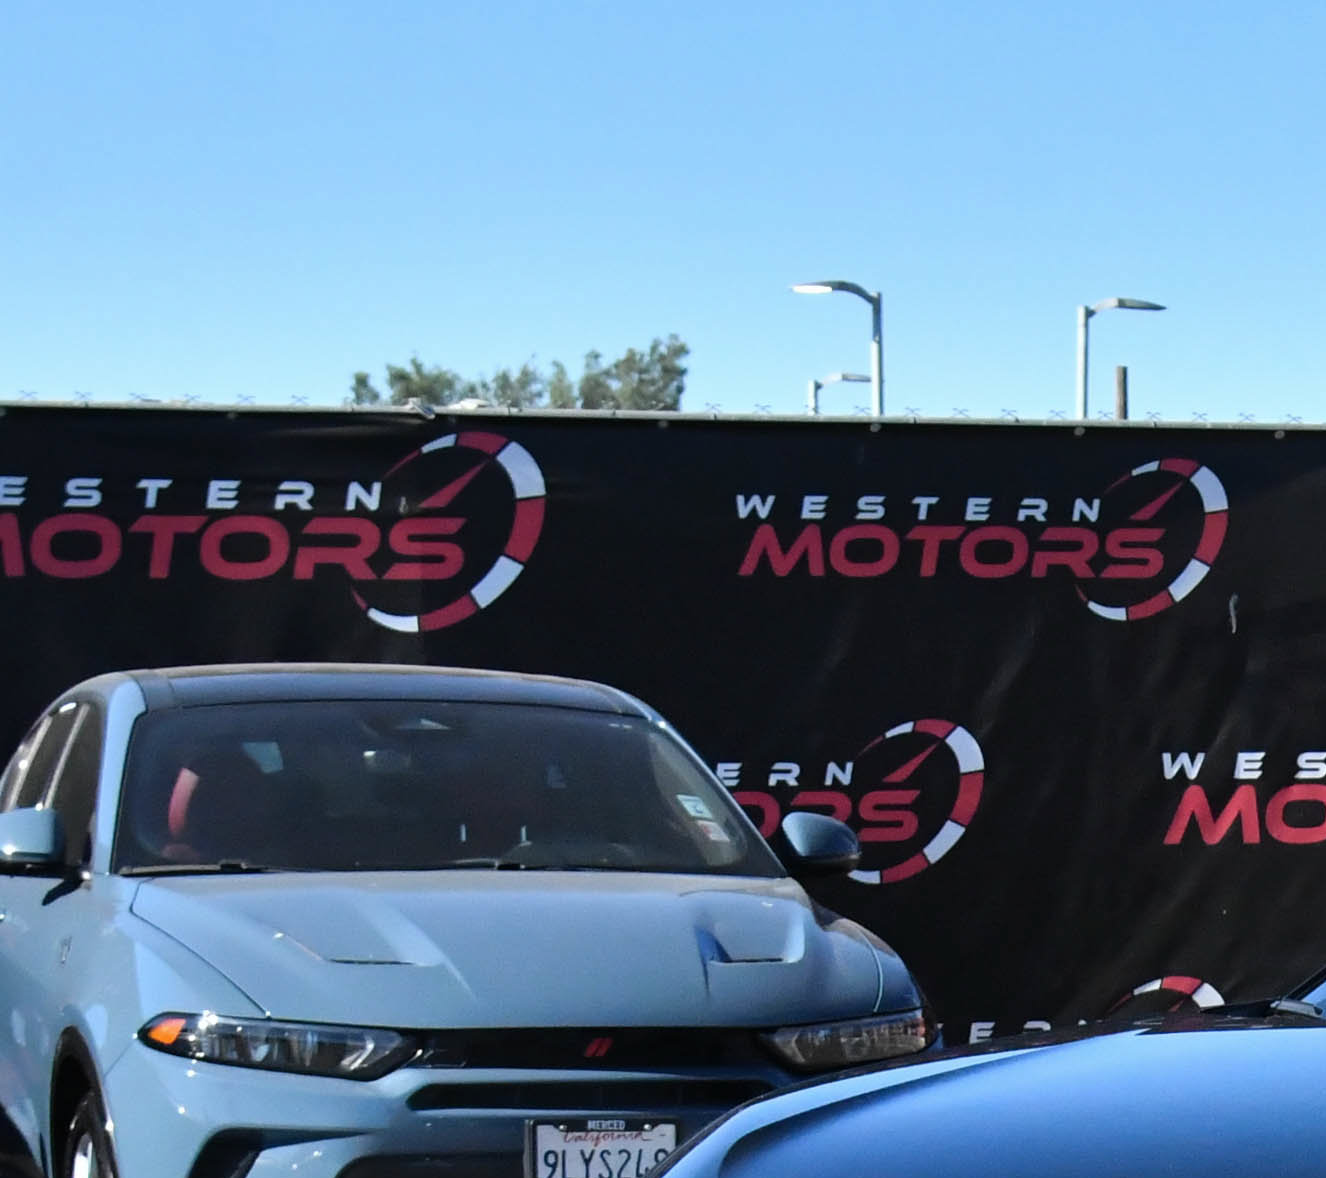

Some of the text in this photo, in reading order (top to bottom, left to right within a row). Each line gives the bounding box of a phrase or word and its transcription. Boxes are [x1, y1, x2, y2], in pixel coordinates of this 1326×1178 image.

[0, 478, 381, 510] ESTERN
[737, 496, 1099, 521] WESTERN
[0, 515, 463, 579] OTORS
[740, 525, 1163, 578] MOTORS
[563, 1131, 653, 1147] California
